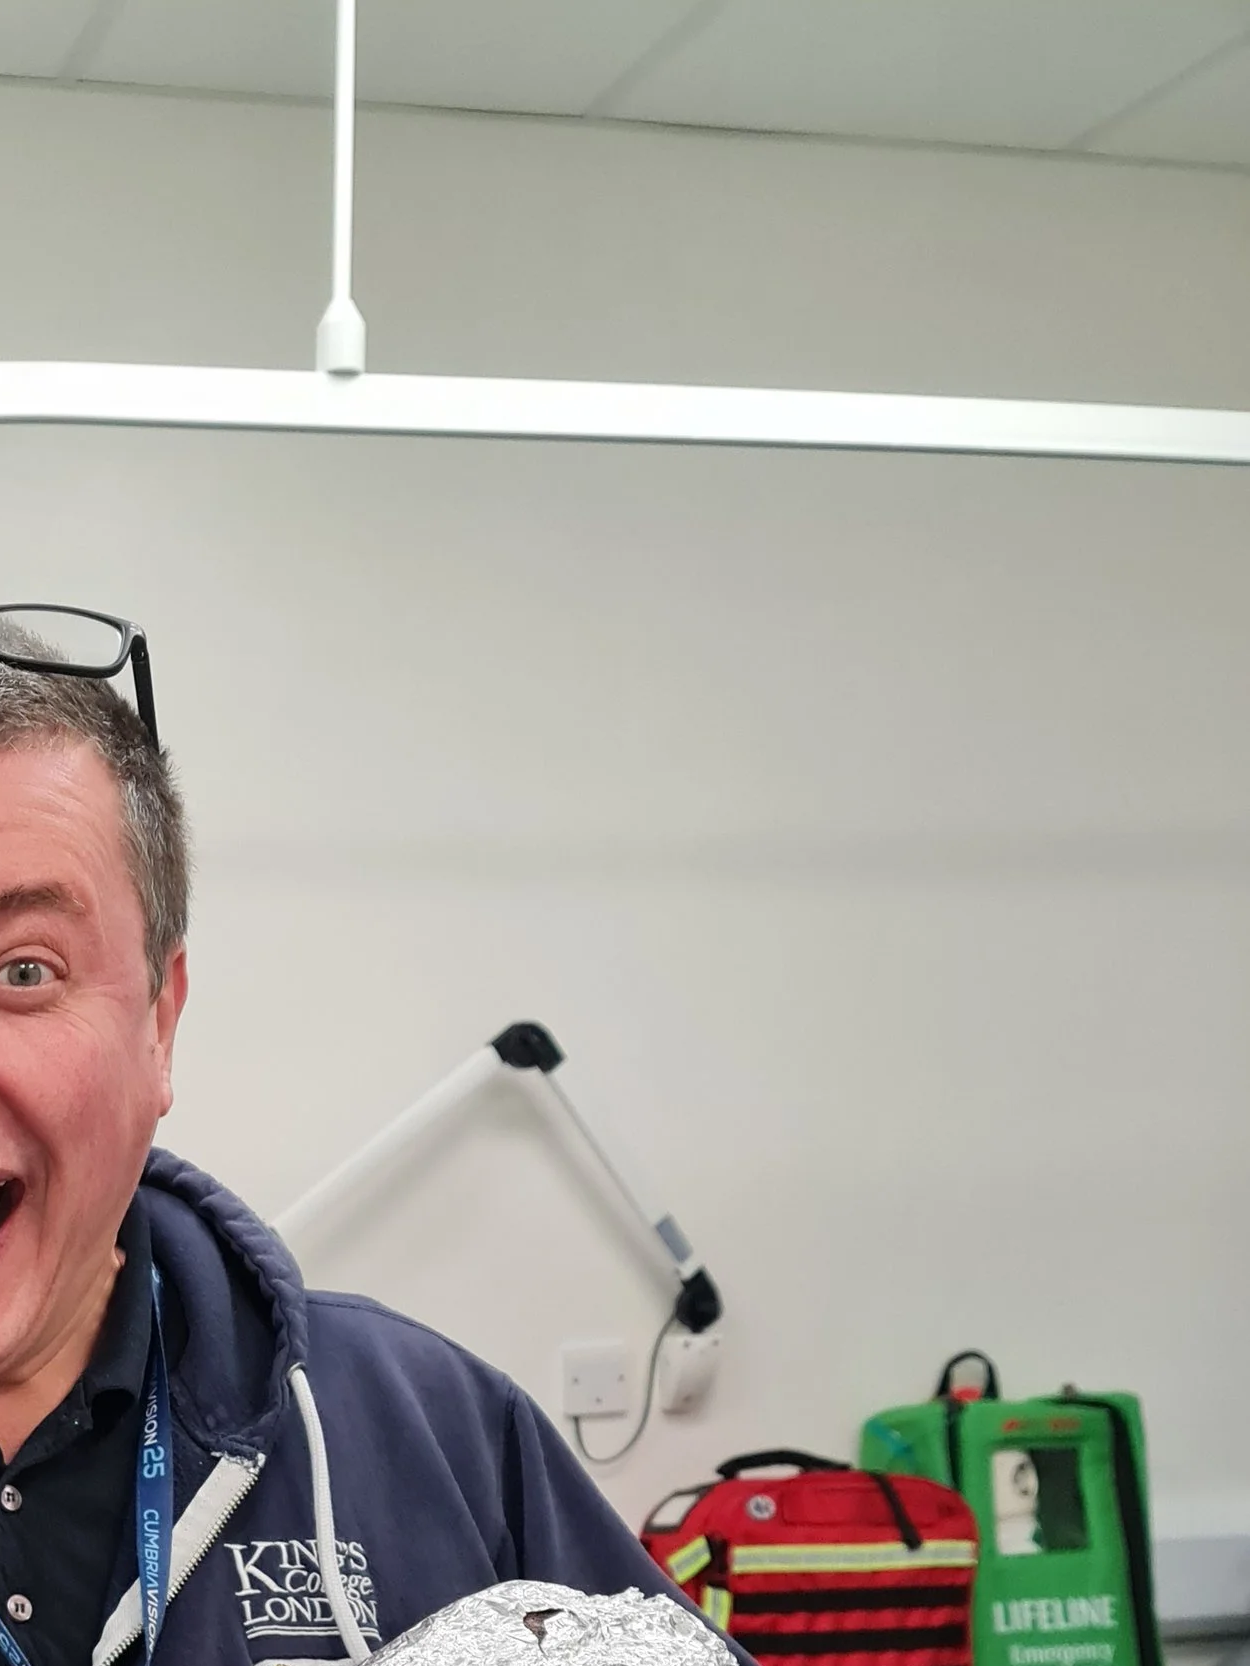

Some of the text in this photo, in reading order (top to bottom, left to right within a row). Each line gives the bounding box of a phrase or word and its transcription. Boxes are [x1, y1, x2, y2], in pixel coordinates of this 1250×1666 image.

[143, 1445, 165, 1479] 25
[285, 1569, 375, 1600] Coege
[992, 1595, 1118, 1633] LIFELINE
